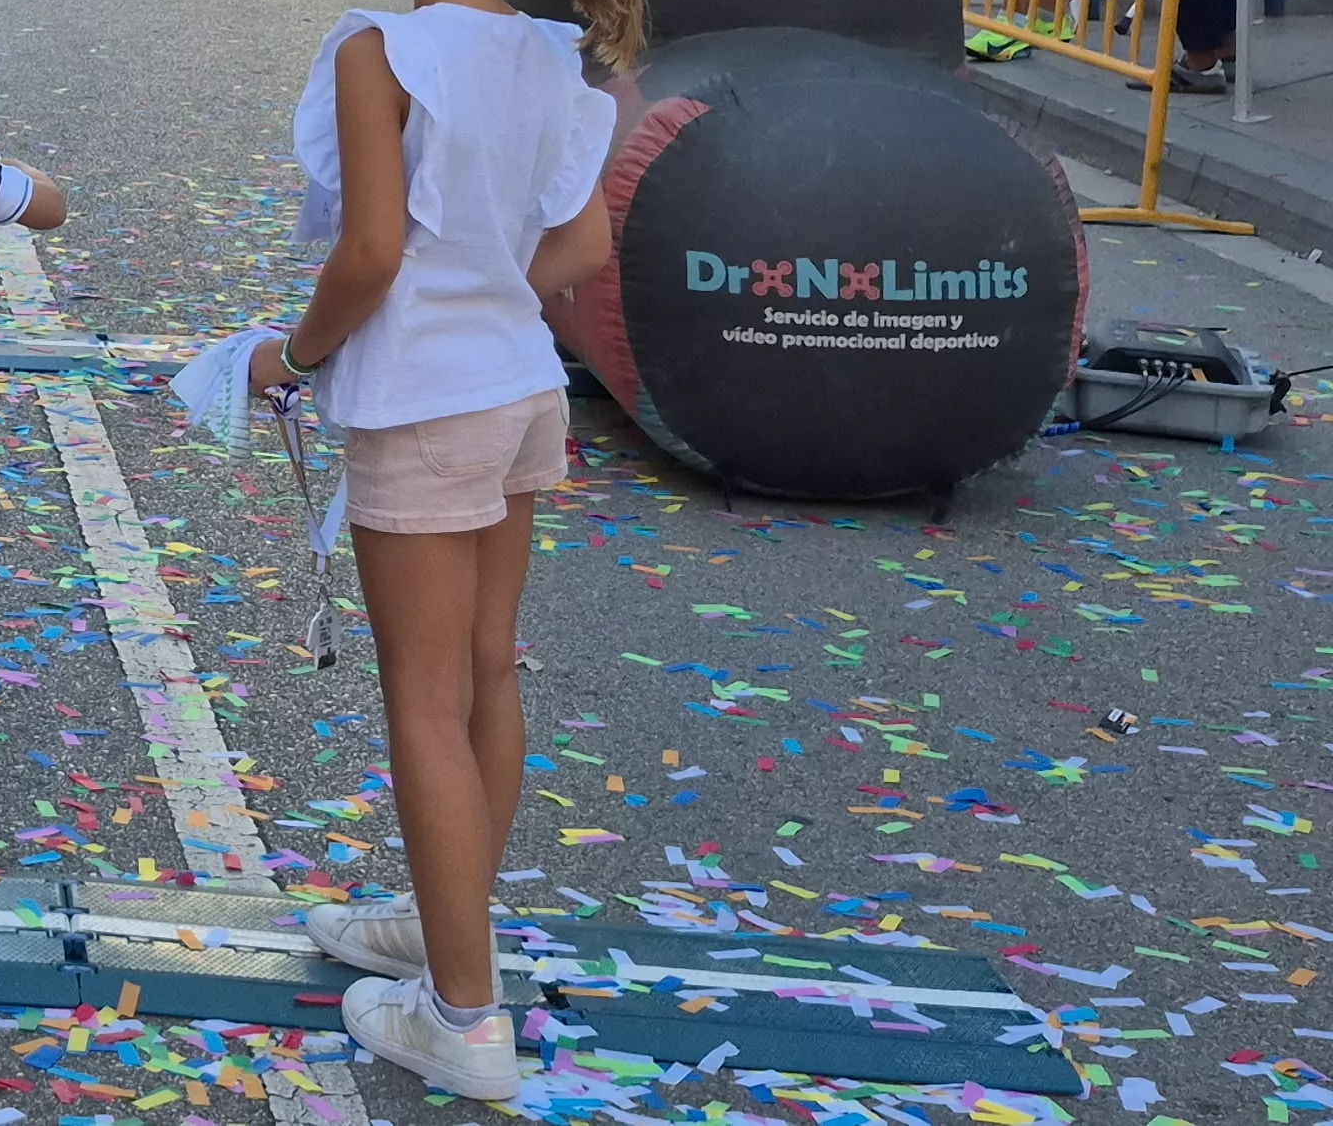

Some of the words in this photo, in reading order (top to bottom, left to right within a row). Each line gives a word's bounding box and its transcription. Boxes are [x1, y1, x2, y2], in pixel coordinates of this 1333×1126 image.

[763, 307, 839, 328] Servicio
[844, 308, 869, 327] de
[873, 310, 947, 331] imagen
[951, 314, 964, 330] y
[722, 326, 778, 345] vídeo
[781, 332, 906, 350] promocional
[910, 333, 1000, 353] deportivo
